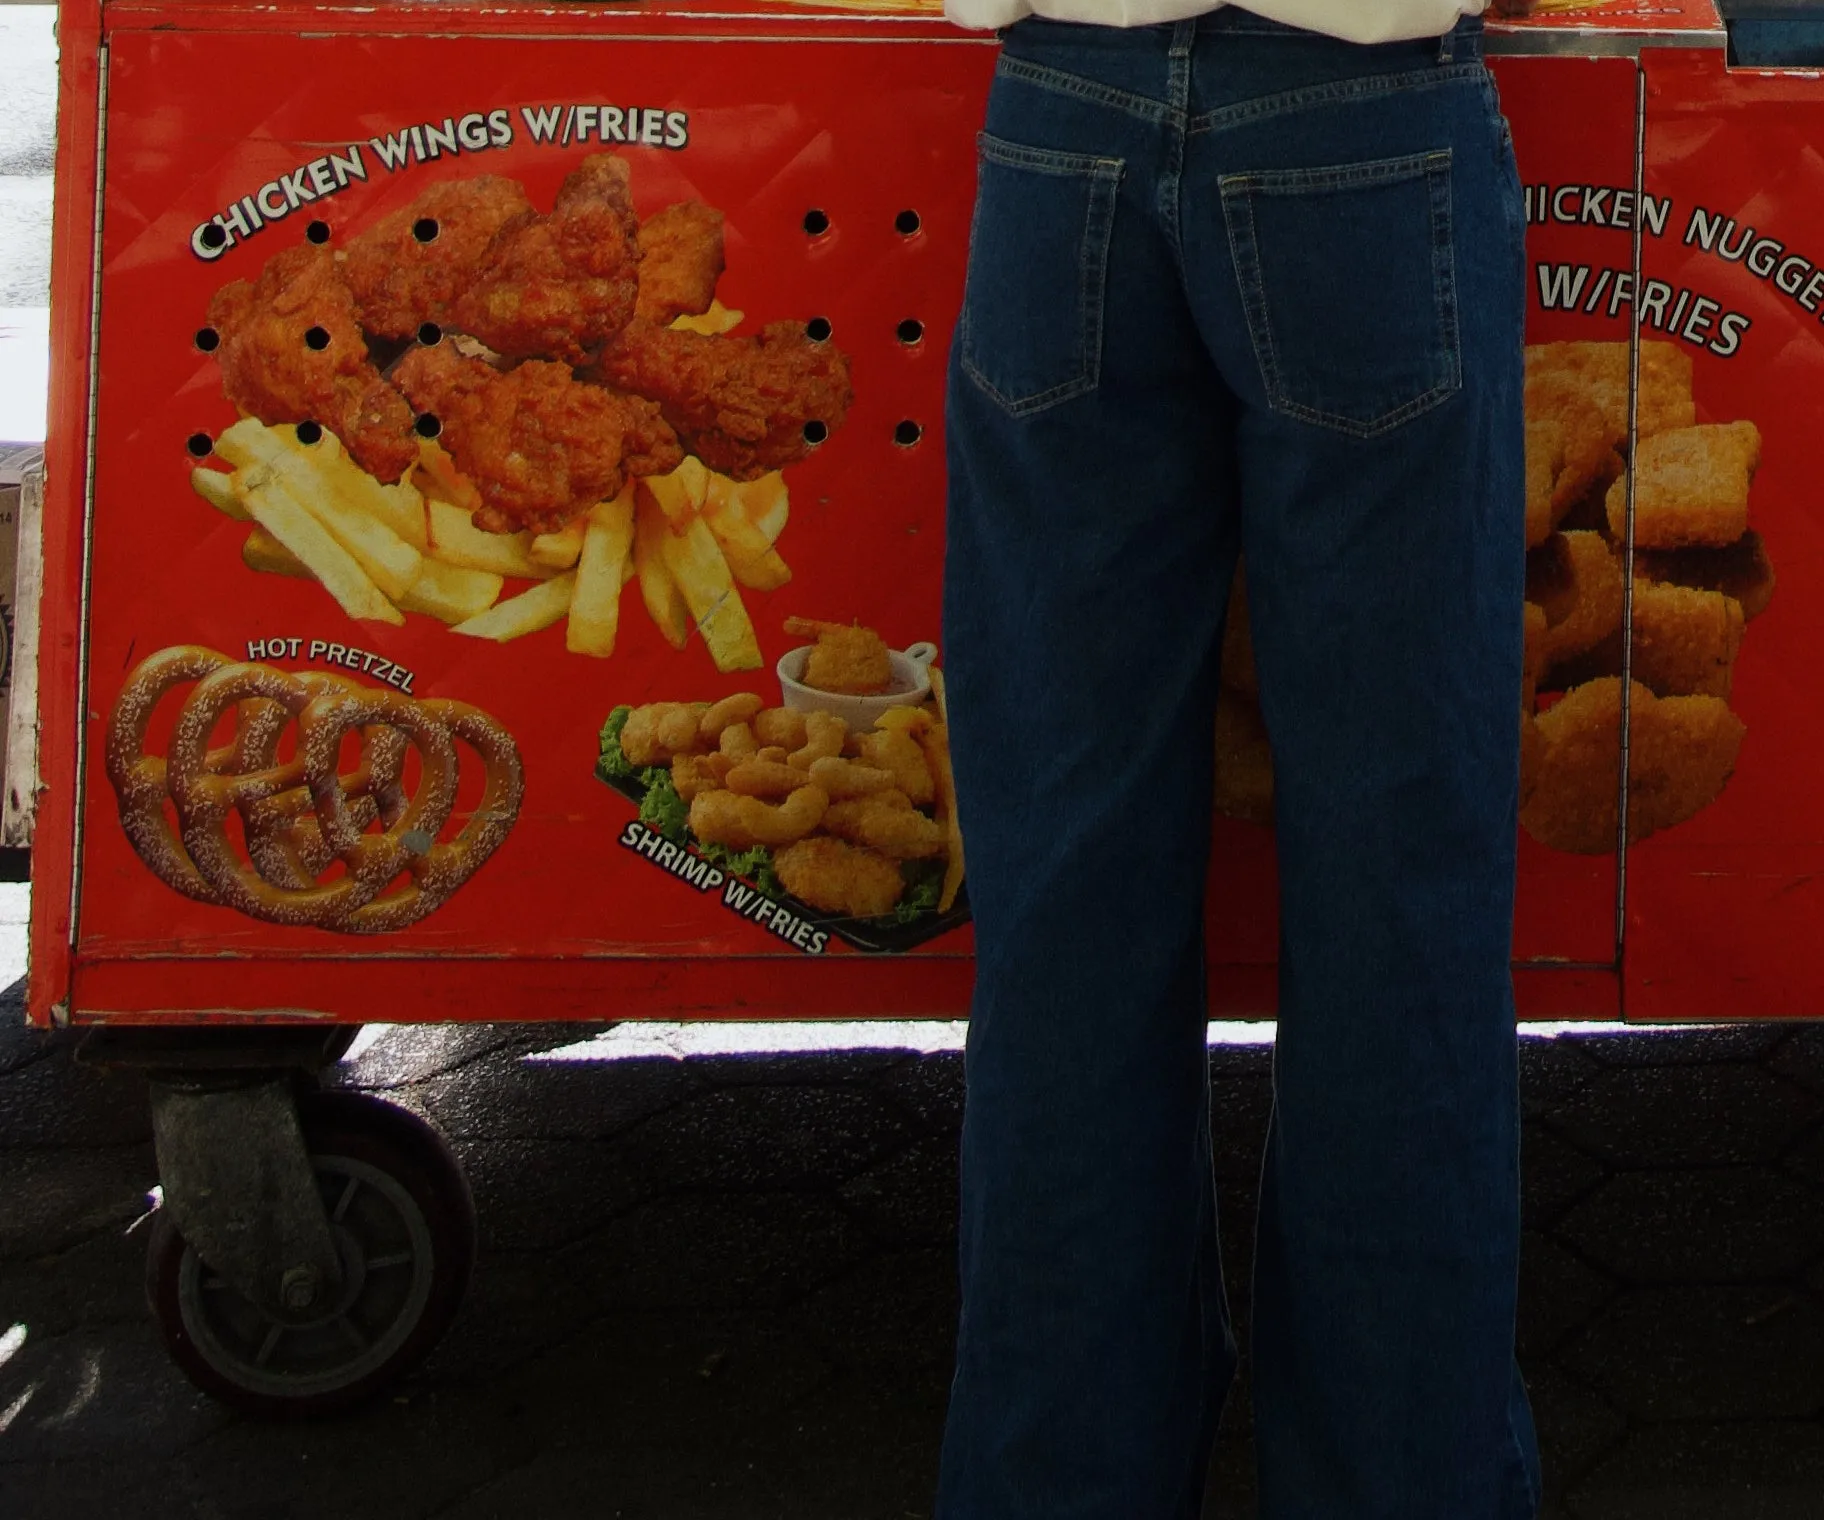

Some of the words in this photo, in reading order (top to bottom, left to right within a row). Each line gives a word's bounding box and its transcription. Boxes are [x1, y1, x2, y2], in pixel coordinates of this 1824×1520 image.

[190, 147, 366, 263] CHICKEN
[369, 107, 514, 173] WINGS
[520, 103, 688, 151] W/FRIES
[1537, 261, 1751, 358] W/FRIES
[246, 637, 304, 662] HOT
[308, 639, 417, 695] PRETZEL
[619, 823, 725, 902] SHRIMP
[722, 890, 831, 955] W/FRIES
